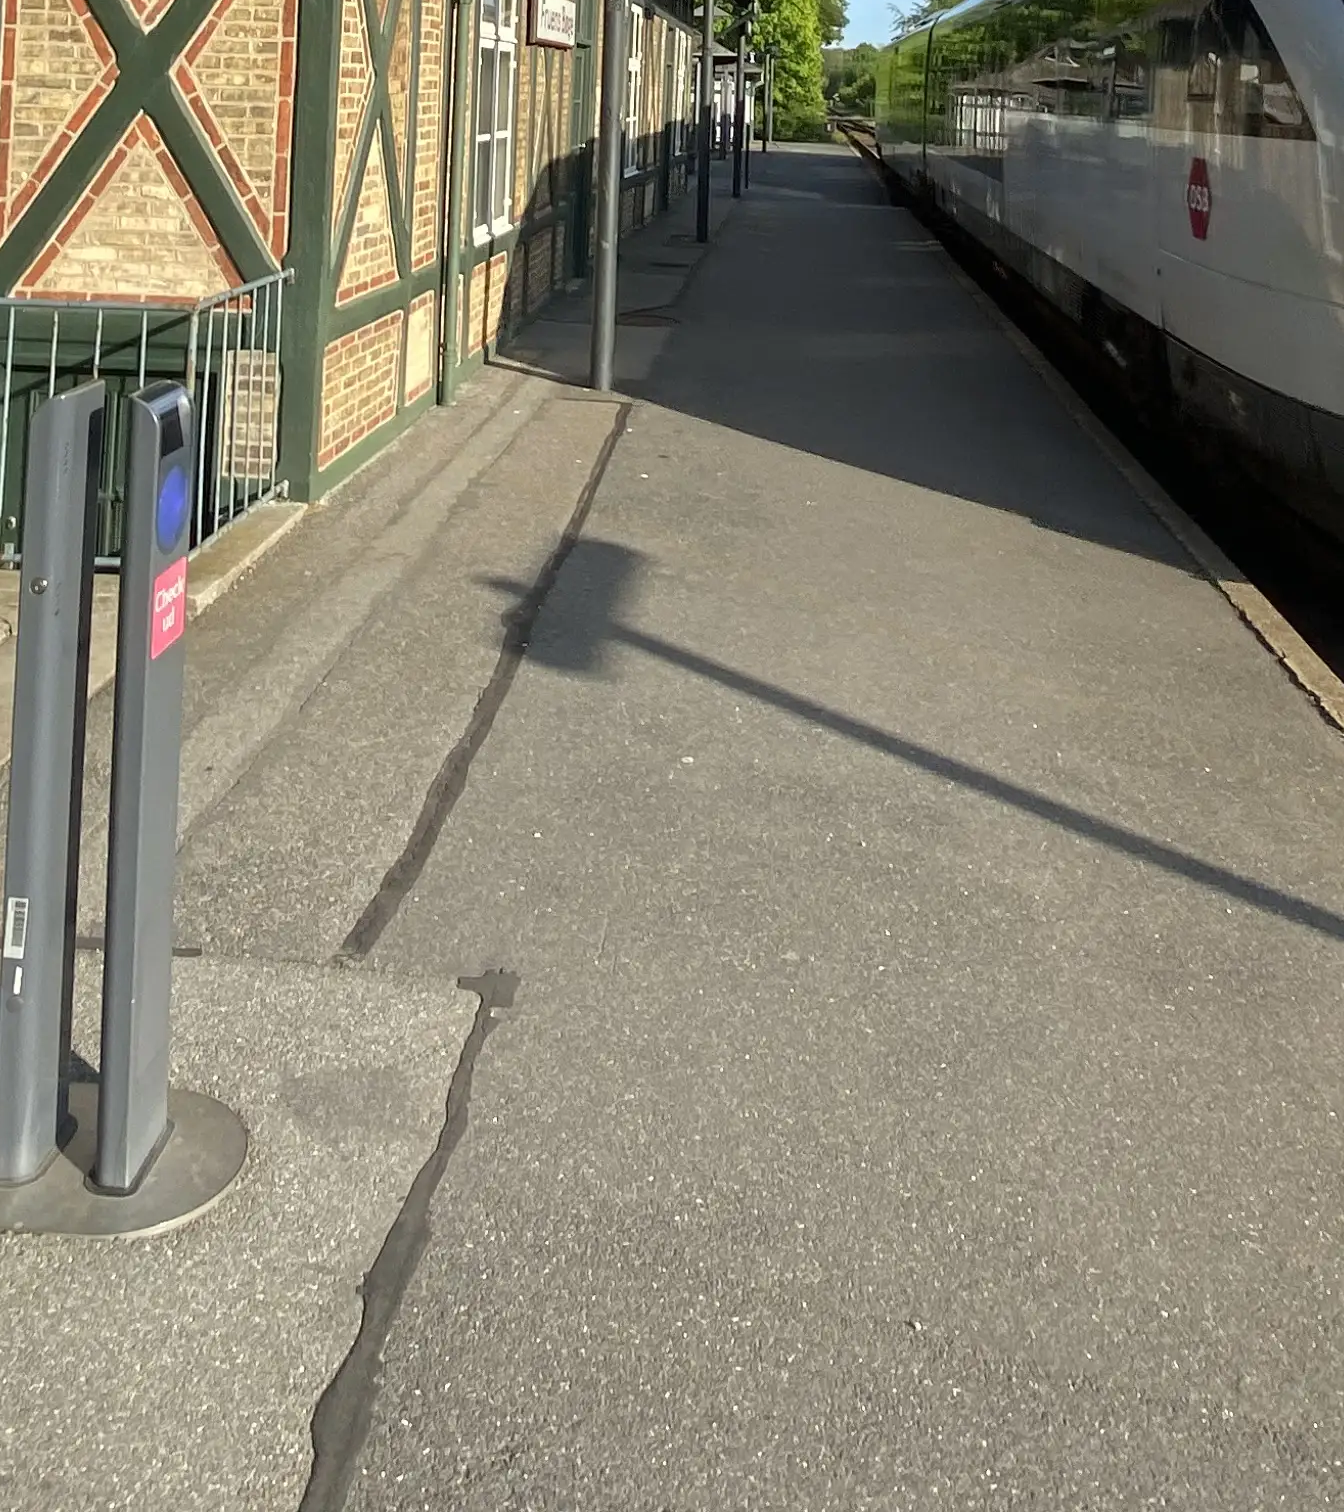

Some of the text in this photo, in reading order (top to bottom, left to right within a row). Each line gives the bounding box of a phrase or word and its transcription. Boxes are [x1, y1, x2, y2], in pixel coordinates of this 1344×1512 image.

[1190, 184, 1208, 212] DSB
[155, 575, 185, 613] Check
[162, 605, 175, 632] ud
